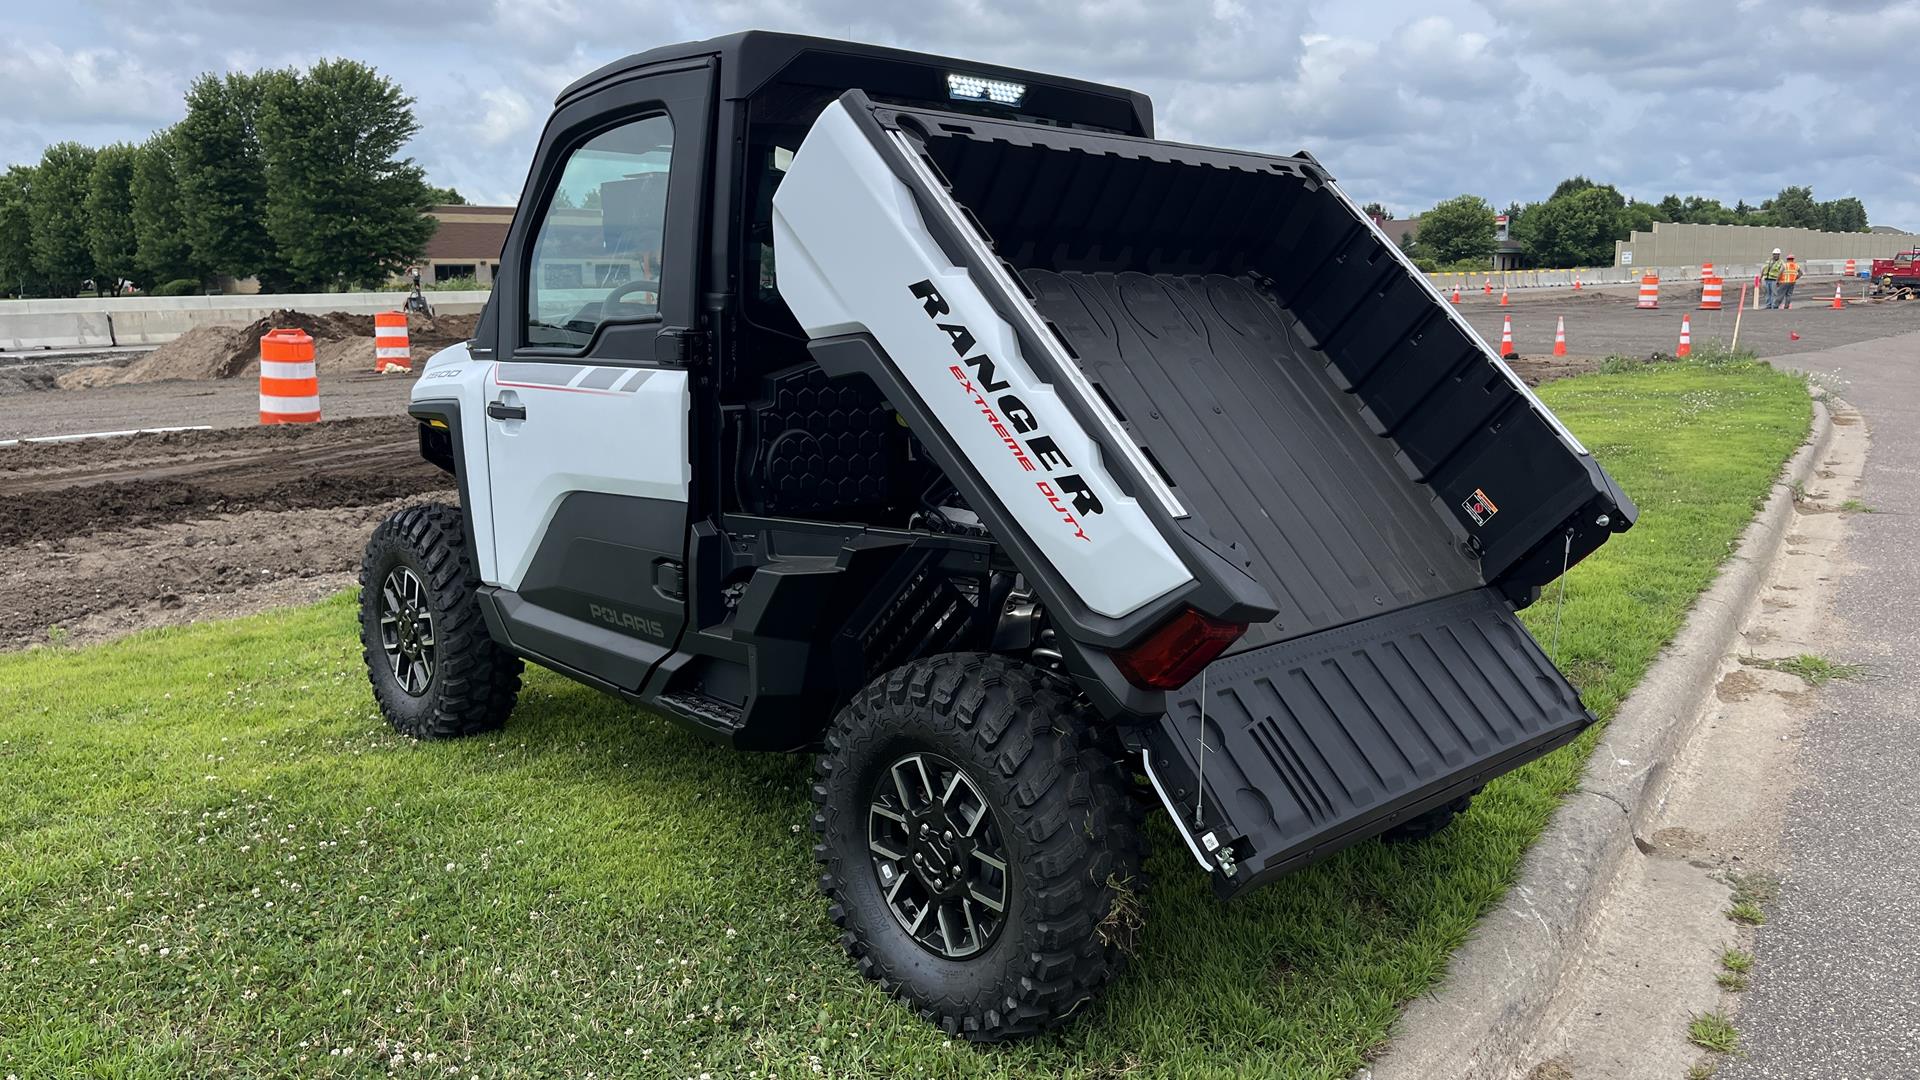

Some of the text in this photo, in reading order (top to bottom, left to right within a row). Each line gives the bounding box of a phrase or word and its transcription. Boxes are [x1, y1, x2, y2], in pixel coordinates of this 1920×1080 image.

[908, 279, 1104, 517] RANGER
[949, 365, 1092, 542] EXTREME DUTY
[589, 603, 665, 638] POLARIS
